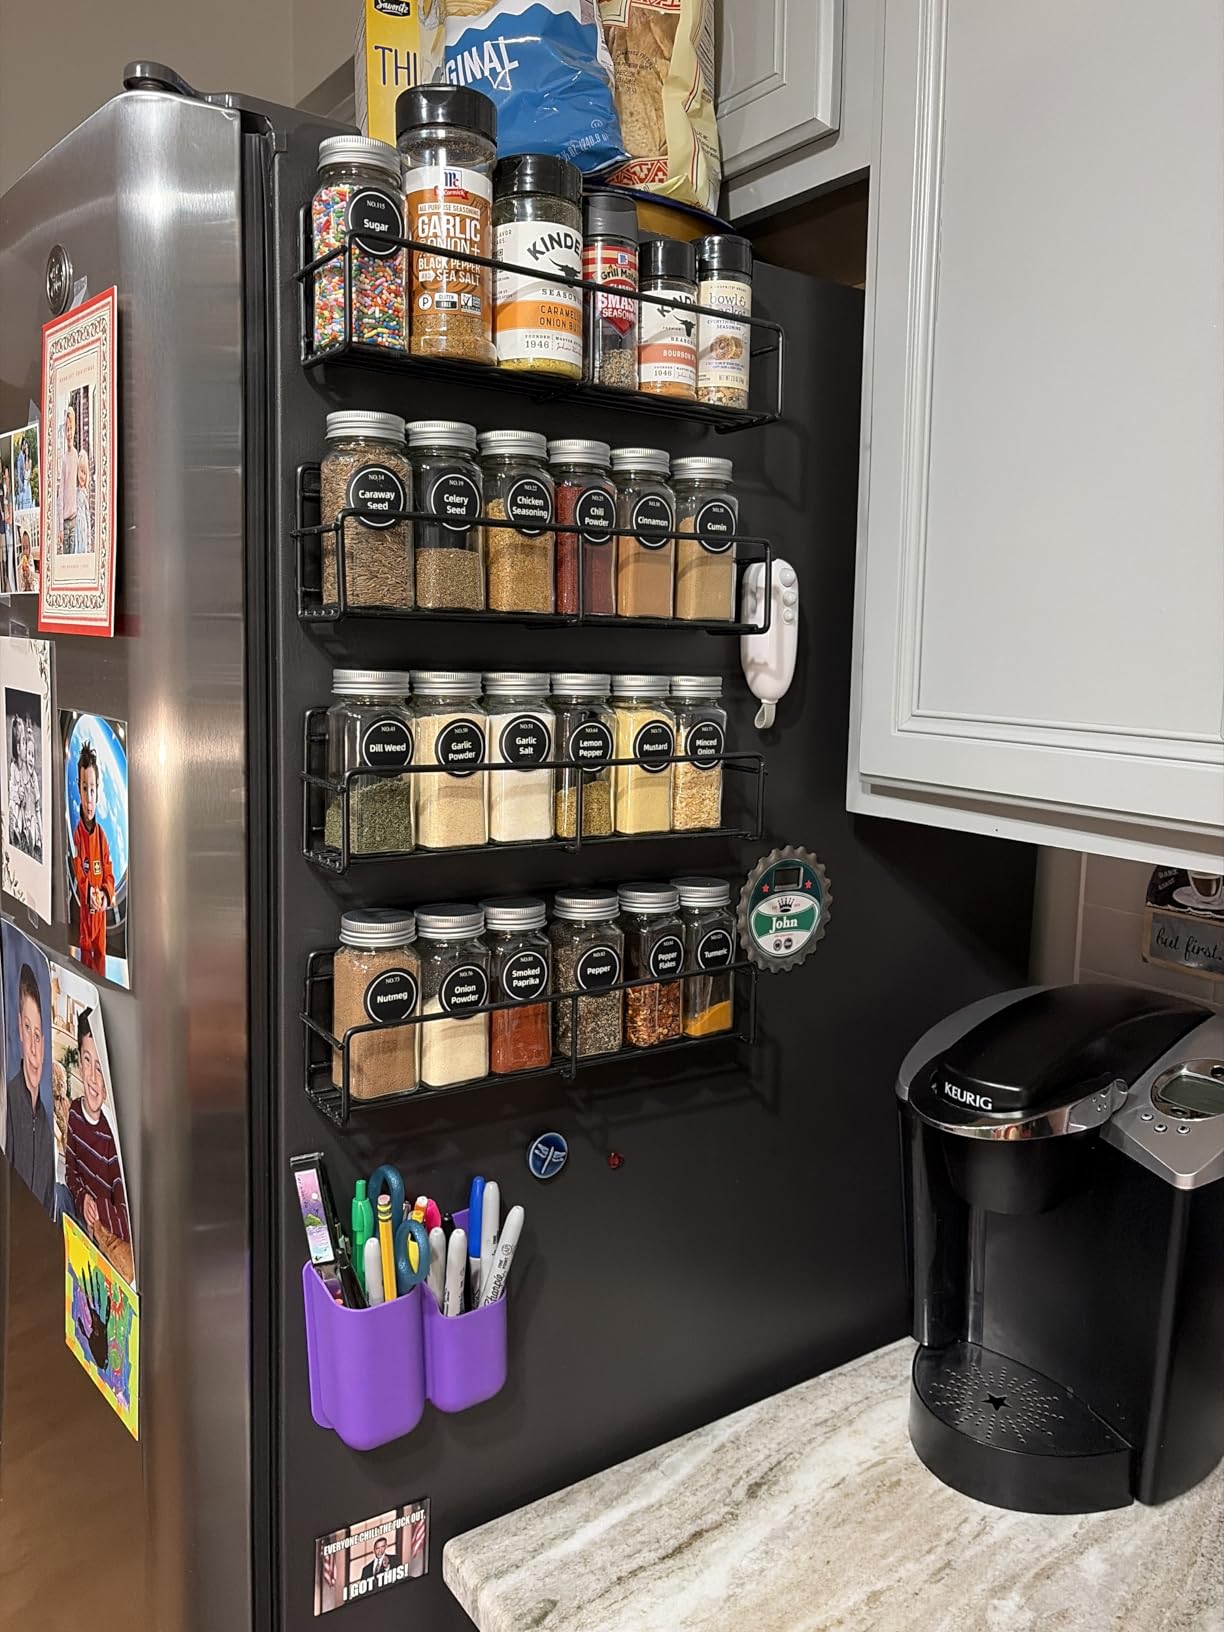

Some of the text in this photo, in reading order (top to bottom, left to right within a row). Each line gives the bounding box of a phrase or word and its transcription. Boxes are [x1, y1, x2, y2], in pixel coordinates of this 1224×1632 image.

[374, 45, 418, 86] THI
[453, 205, 480, 216] SEASONING
[363, 218, 389, 232] Sugar
[418, 215, 481, 241] GARLIC
[527, 231, 582, 261] KINDE
[418, 257, 481, 275] BLACK PEPPER
[436, 269, 457, 282] SEA
[458, 271, 481, 286] SALT
[600, 269, 619, 280] Grill
[600, 292, 636, 313] SMAS
[709, 292, 747, 308] bowl &
[539, 317, 566, 329] ONION
[525, 340, 550, 349] 1946
[663, 350, 691, 361] BOURBON
[368, 473, 385, 482] NO.14
[358, 489, 396, 501] Caraway
[443, 494, 469, 506] Celery
[367, 501, 389, 511] Seed
[517, 496, 544, 506] Chicken
[446, 505, 467, 515] Seed
[512, 506, 548, 519] Seasoning
[590, 507, 605, 517] Chili
[584, 516, 610, 527] Powder
[637, 516, 669, 527] Cinnamon
[707, 522, 728, 532] Cumin
[451, 741, 472, 750] Garlic
[515, 736, 537, 745] Garlic
[579, 740, 603, 748] Lemon
[695, 739, 718, 747] Minced
[369, 743, 407, 753] Dill Weed
[519, 746, 534, 755] Salt
[643, 742, 668, 751] Mustard
[697, 748, 715, 756] Onion
[448, 751, 476, 761] Powder
[579, 749, 604, 758] Pepper
[769, 916, 798, 934] John
[1156, 927, 1180, 950] but
[658, 952, 678, 961] Pepper
[704, 948, 728, 958] Turmeric
[587, 965, 611, 975] Pepper
[659, 961, 676, 970] Flakes
[512, 967, 541, 978] Smoked
[513, 978, 539, 988] Paprika
[455, 984, 476, 994] Onion
[377, 991, 408, 1004] Nutmeg
[451, 994, 479, 1005] Powder
[944, 1081, 993, 1110] KEURIG
[323, 1534, 359, 1556] EVERYONE
[359, 1529, 378, 1543] CHILL
[379, 1524, 392, 1535] THE
[392, 1515, 410, 1529] FUCK
[343, 1563, 409, 1601] I GOT THIS!
